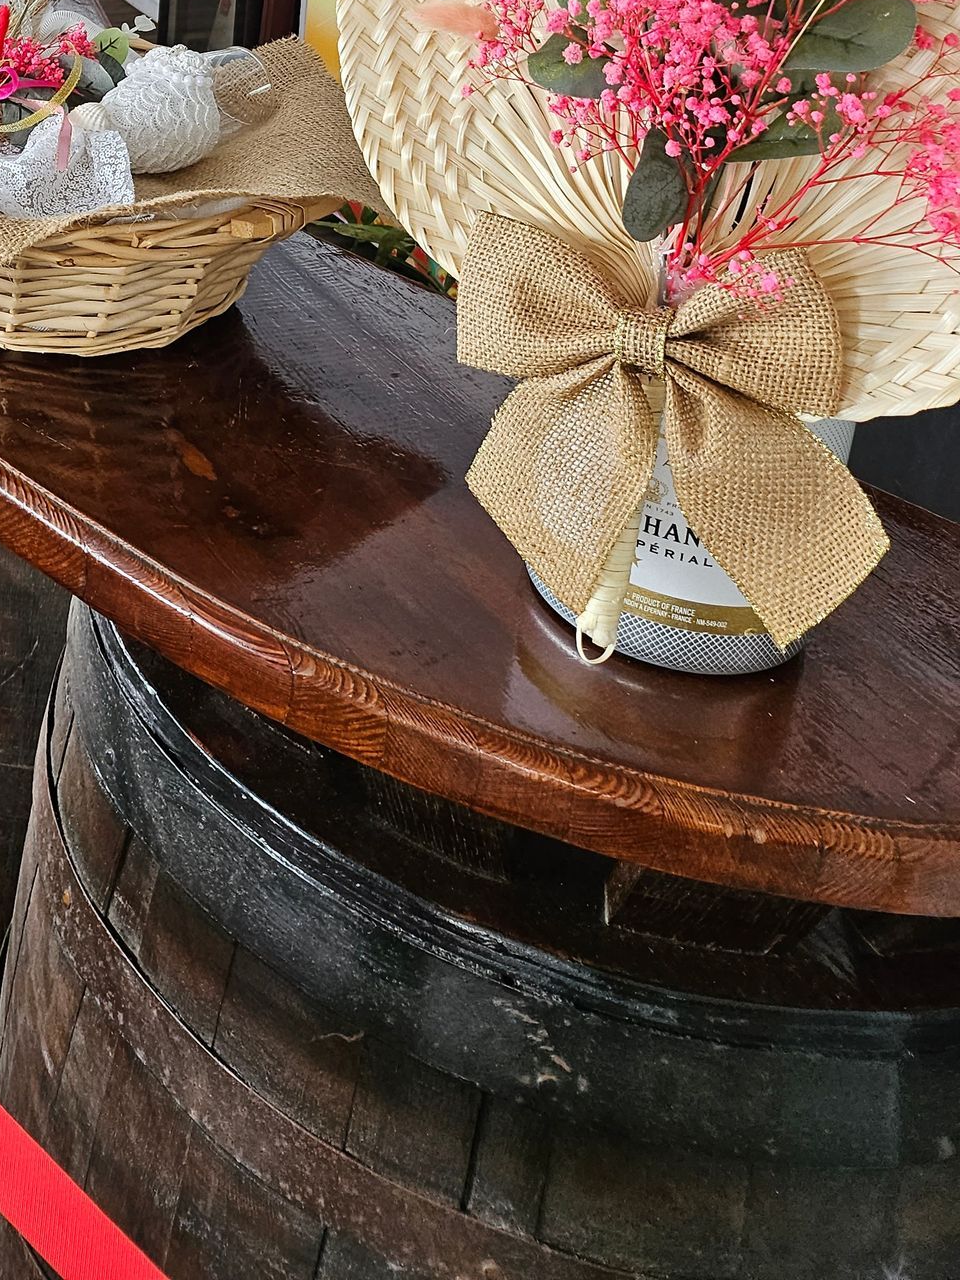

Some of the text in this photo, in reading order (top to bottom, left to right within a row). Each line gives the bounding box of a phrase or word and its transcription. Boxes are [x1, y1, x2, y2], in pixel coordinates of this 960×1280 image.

[656, 506, 674, 517] 1743
[631, 592, 696, 617] PRODUCT OF FRANCE
[671, 613, 693, 624] FRANCE
